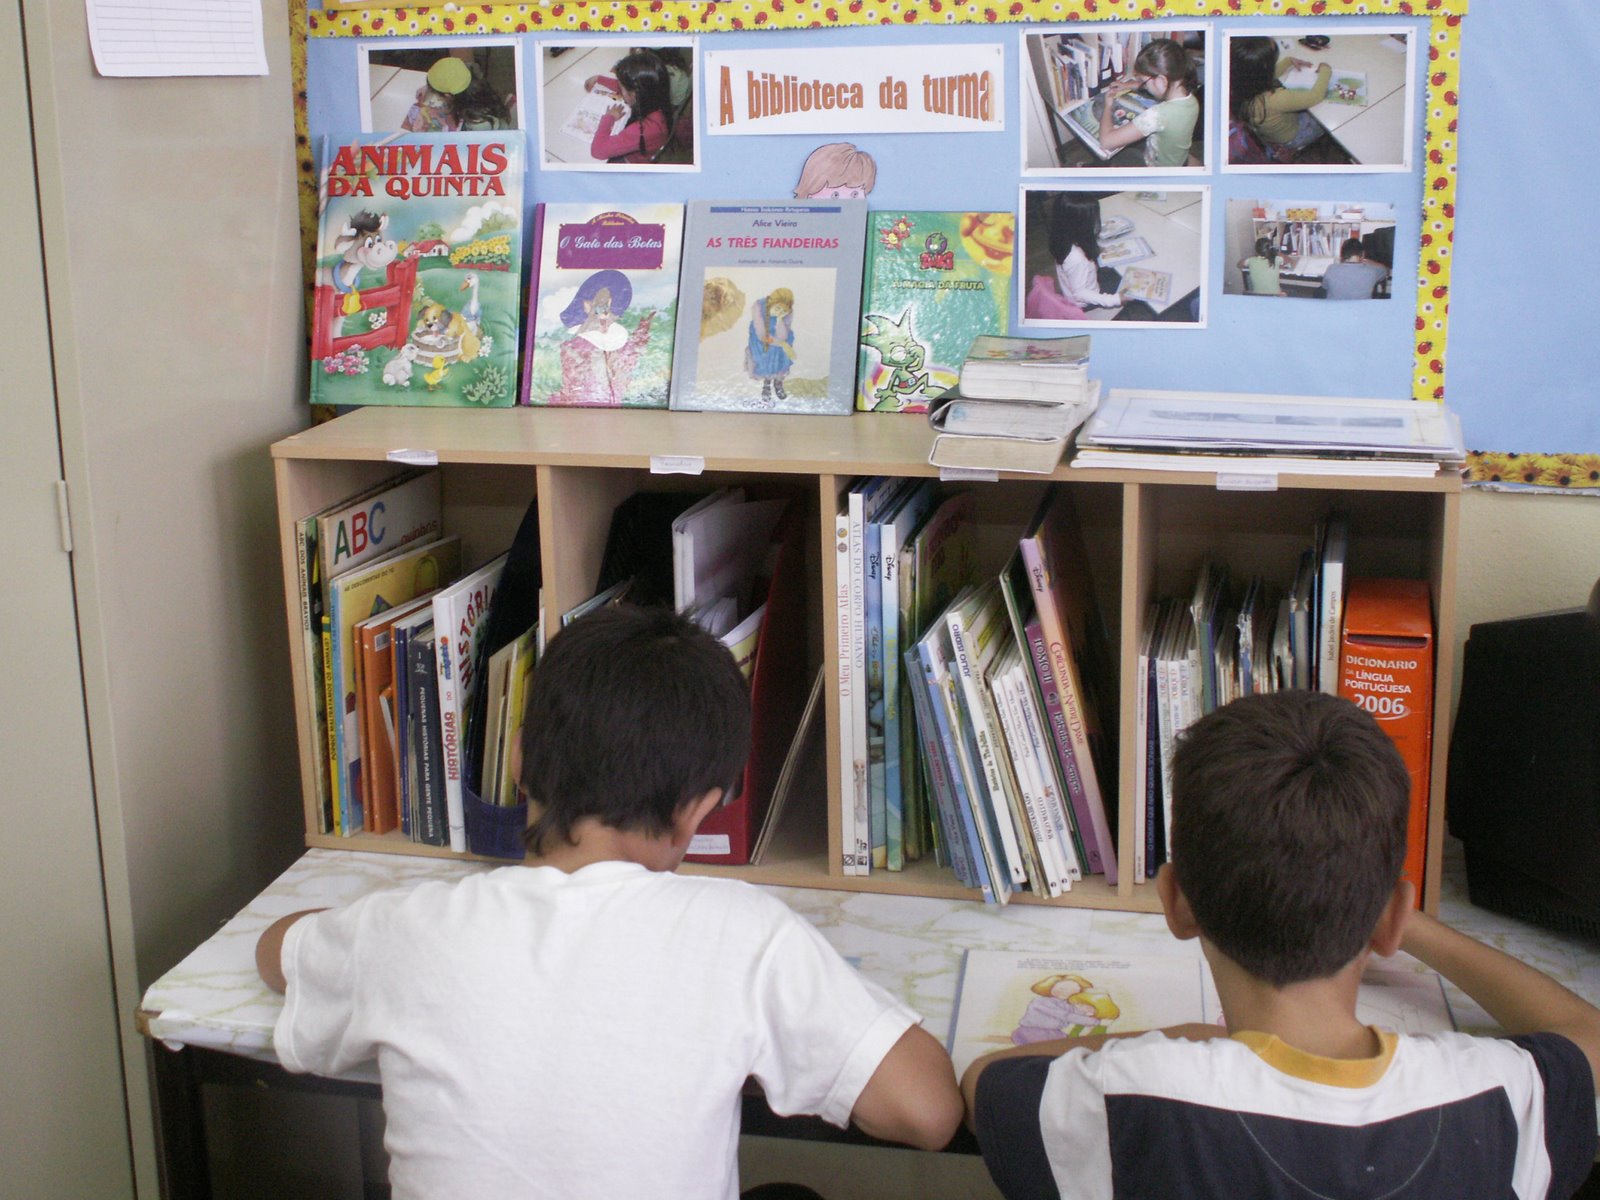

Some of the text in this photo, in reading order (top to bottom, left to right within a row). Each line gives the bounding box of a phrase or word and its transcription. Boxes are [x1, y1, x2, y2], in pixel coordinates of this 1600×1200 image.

[720, 65, 991, 126] A biblioteca da turma
[327, 143, 508, 176] ANIMAIS
[327, 176, 506, 200] DA QUINTA
[559, 236, 662, 249] O Gato das Botas
[706, 235, 839, 249] AS TRÊS FIANDEIRAS
[953, 280, 985, 291] FRUTA
[334, 501, 386, 566] ABC
[868, 552, 880, 580] Disney
[884, 553, 896, 581] Disney
[1032, 565, 1044, 593] Disney
[852, 522, 863, 669] ATLAS DO CORPO HUMANO
[837, 583, 849, 697] O Meu Primeiro Atlas
[952, 624, 965, 652] ISIDRO
[1033, 638, 1049, 671] TOMO
[1344, 679, 1411, 693] PORTUGUESA
[1356, 670, 1394, 682] LÍNGUA
[1354, 693, 1405, 715] 2006
[421, 725, 429, 761] HISTÓRIAS
[444, 711, 459, 781] HISTÓRIAS
[1053, 712, 1080, 794] Fábulas de sempre
